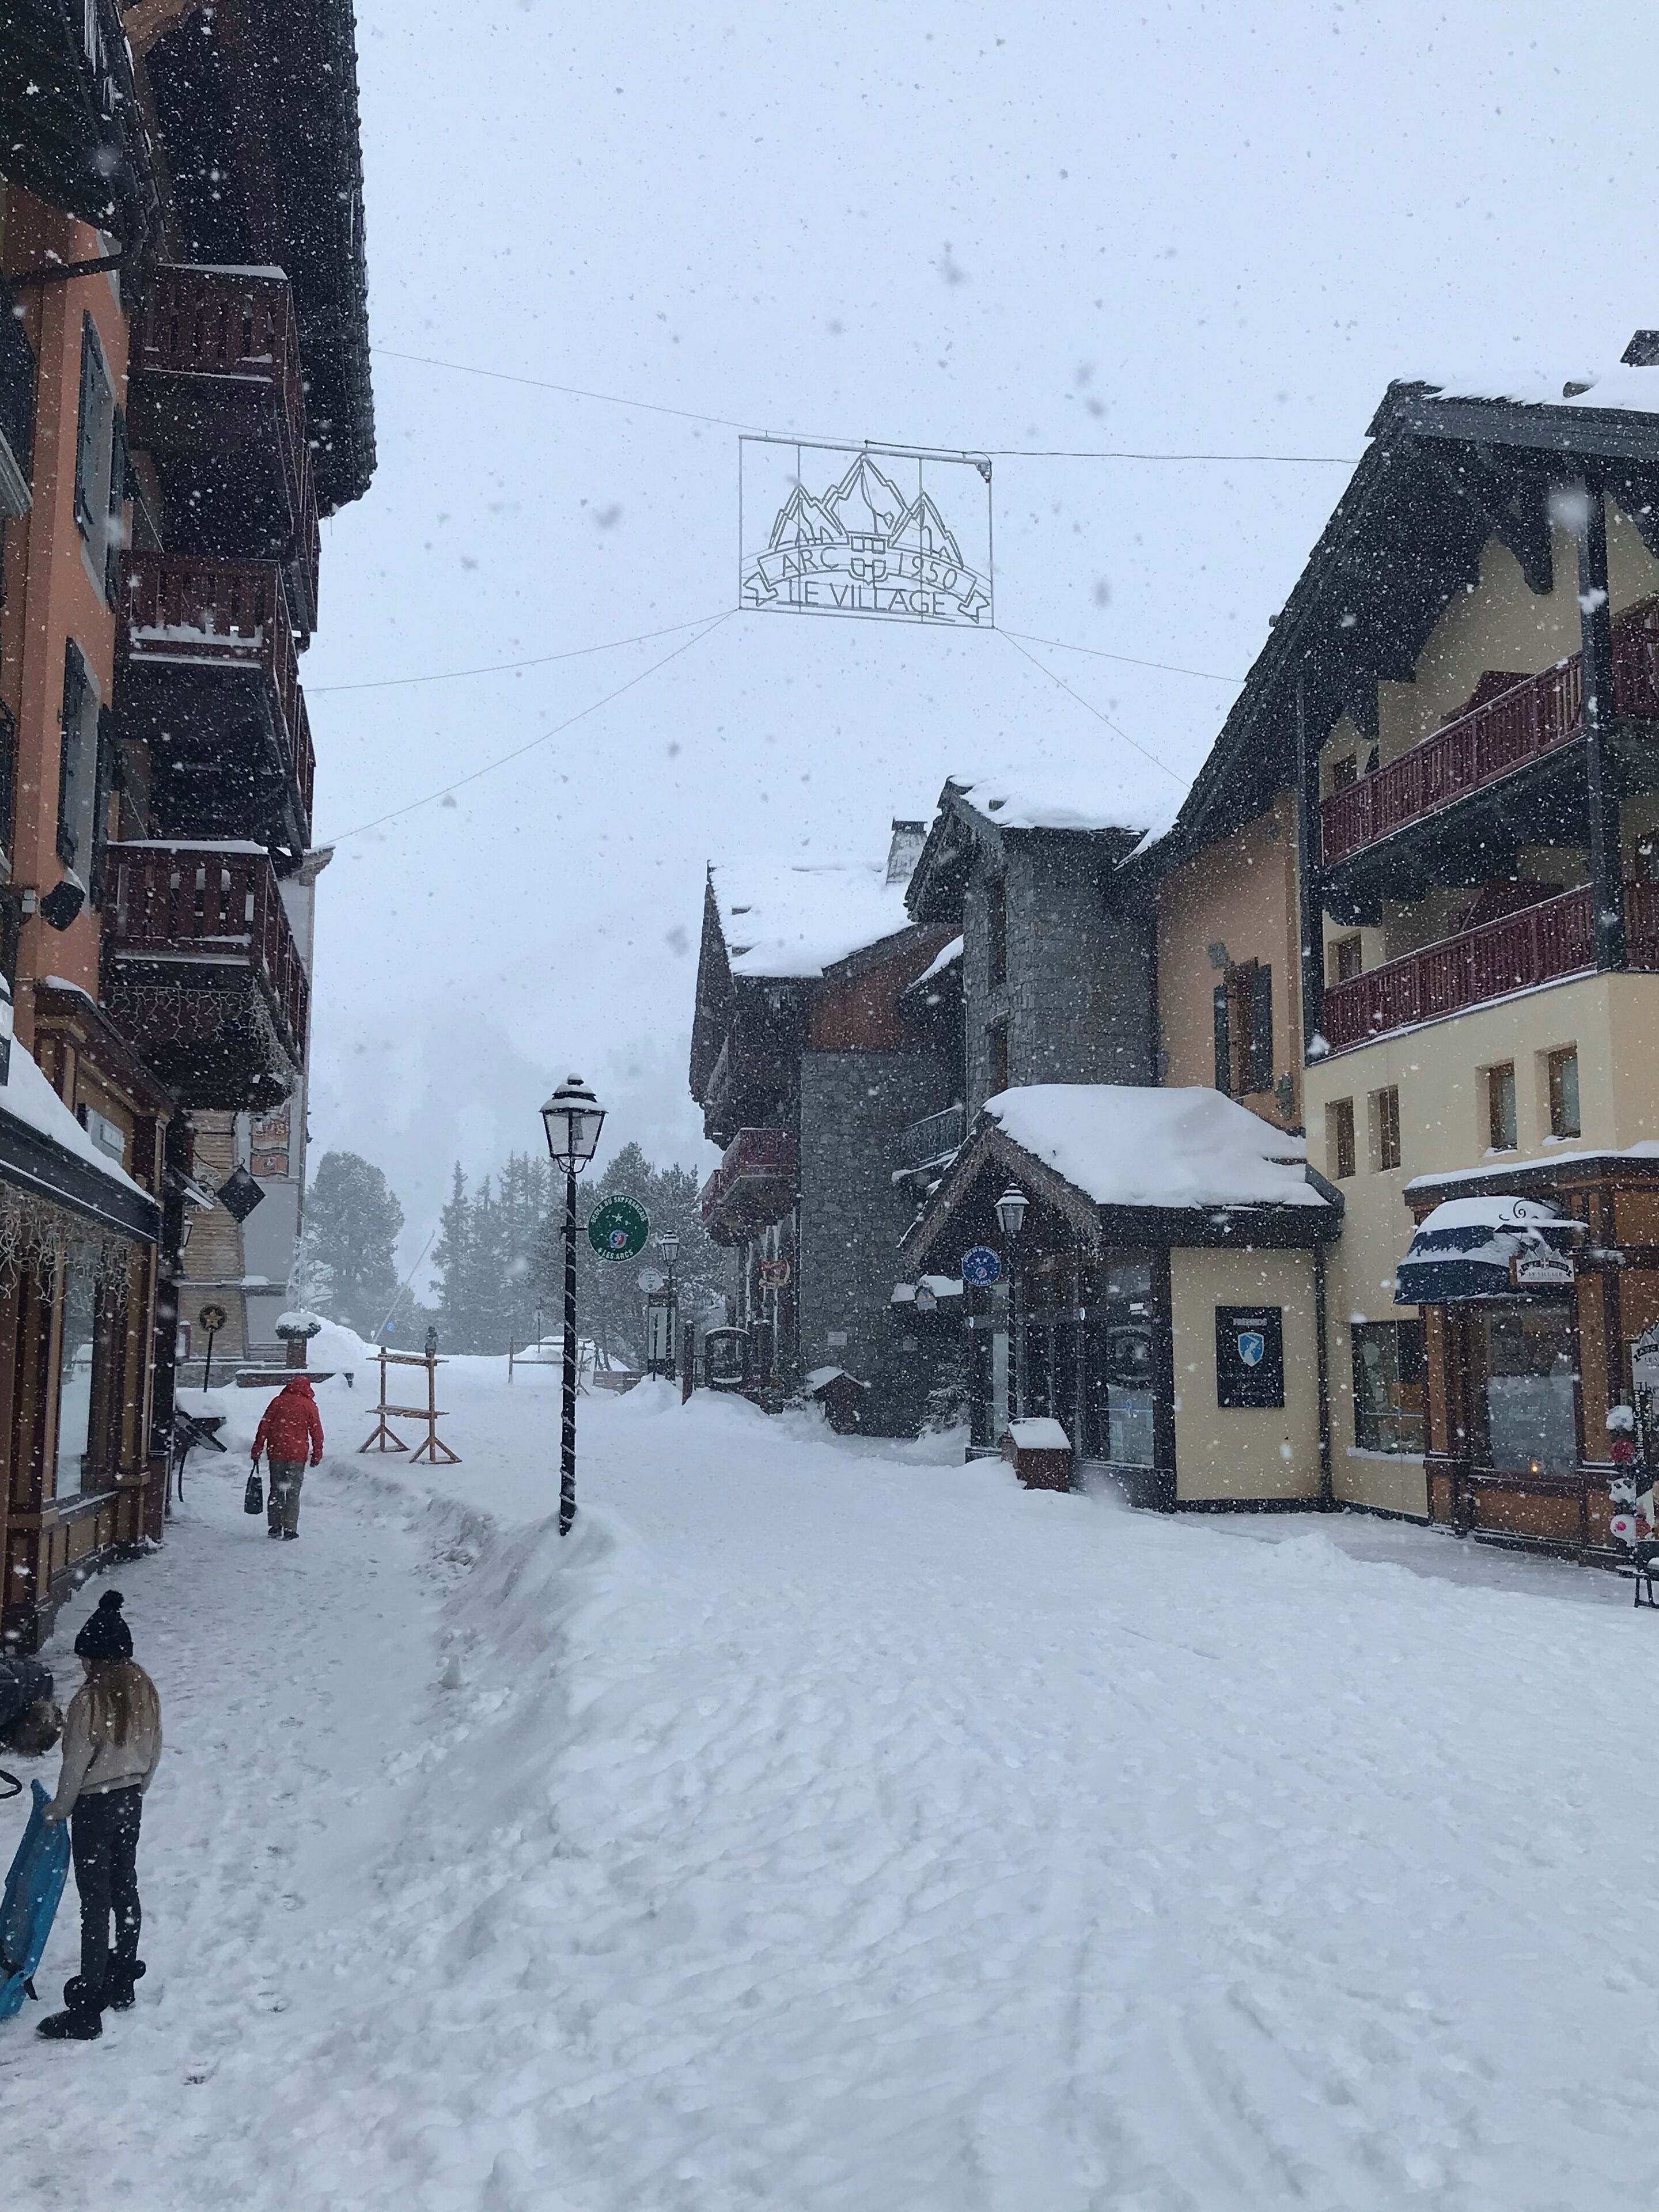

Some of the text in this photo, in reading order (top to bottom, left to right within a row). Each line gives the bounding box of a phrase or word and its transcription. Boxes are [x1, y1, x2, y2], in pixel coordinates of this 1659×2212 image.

[782, 546, 957, 590] ARC 1950
[789, 579, 946, 616] LE VILLAGE
[590, 1204, 605, 1223] ECOLE
[604, 1198, 612, 1207] DU
[601, 1249, 634, 1260] LES ARCS
[1636, 1448, 1645, 1461] Ski
